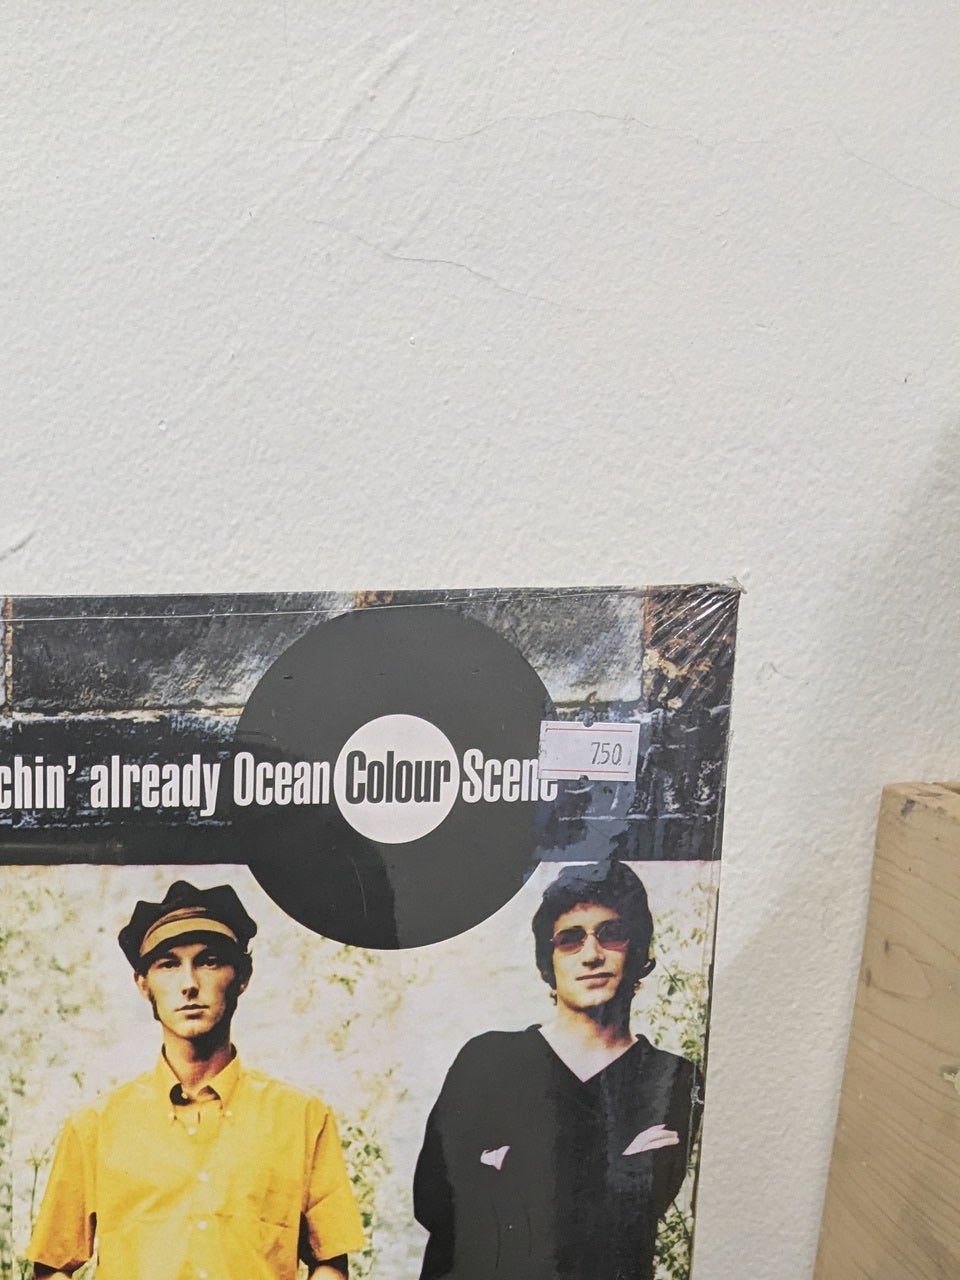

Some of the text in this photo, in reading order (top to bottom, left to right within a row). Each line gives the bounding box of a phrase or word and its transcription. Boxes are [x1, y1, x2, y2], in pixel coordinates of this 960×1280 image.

[90, 754, 221, 817] already
[234, 751, 330, 806] Ocean
[345, 750, 451, 804] Colour
